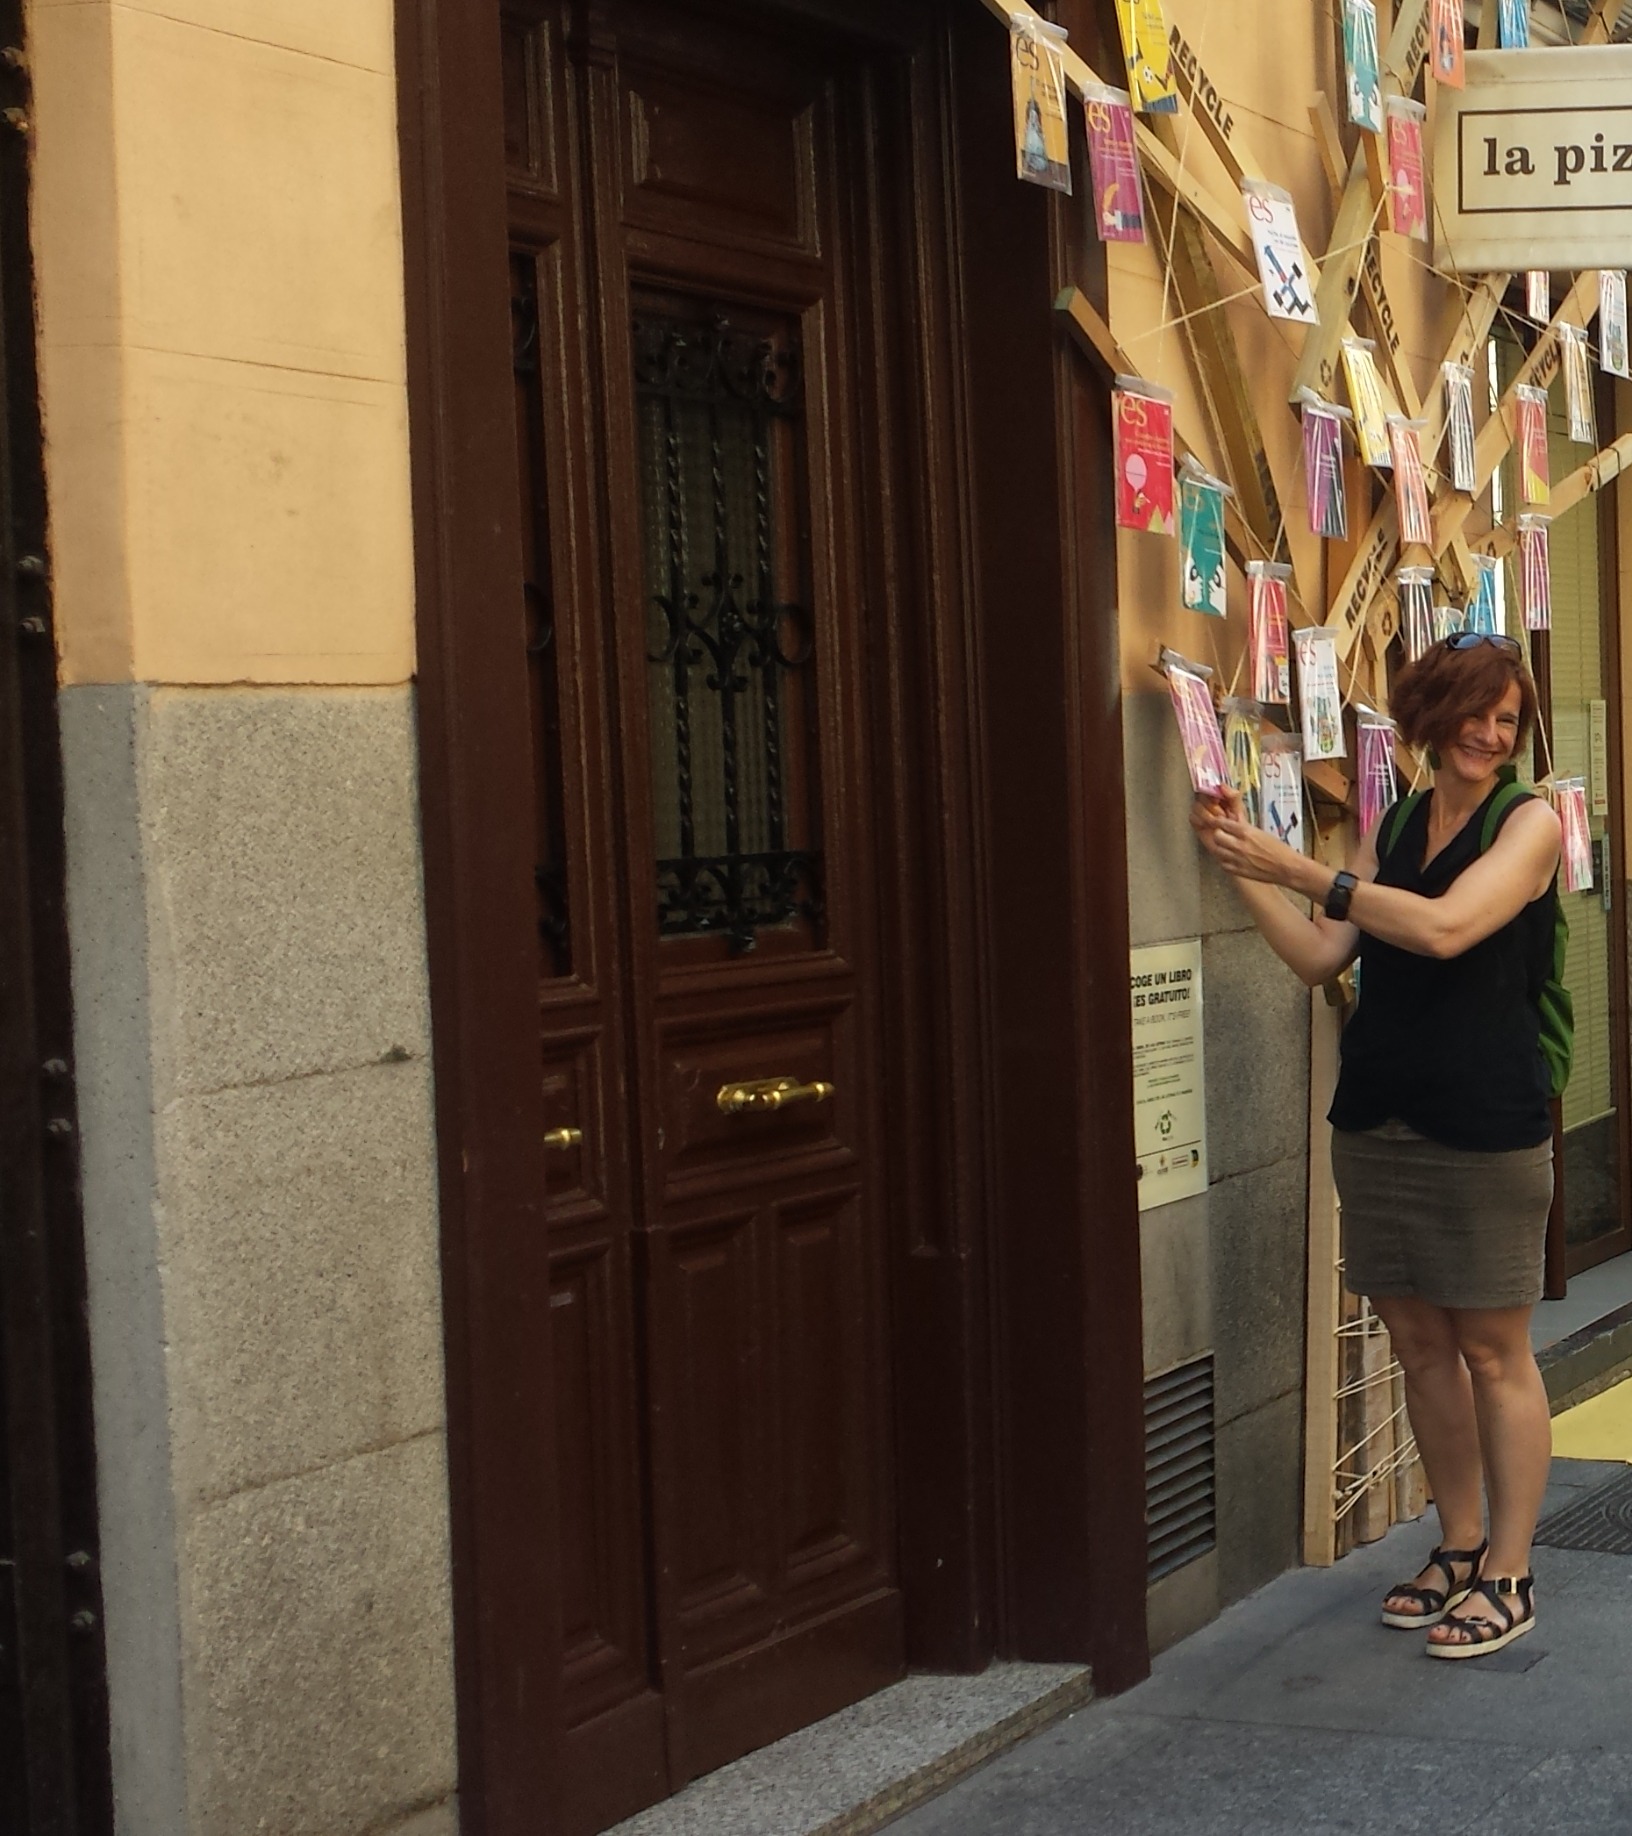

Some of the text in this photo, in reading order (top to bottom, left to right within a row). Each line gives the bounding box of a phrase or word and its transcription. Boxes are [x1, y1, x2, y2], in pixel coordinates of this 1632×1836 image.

[1483, 137, 1535, 176] la
[1249, 195, 1274, 224] es
[1120, 396, 1148, 427] es
[1154, 972, 1167, 986] UN
[1169, 968, 1192, 983] LIBRO
[1148, 987, 1190, 1005] GRATUITO!
